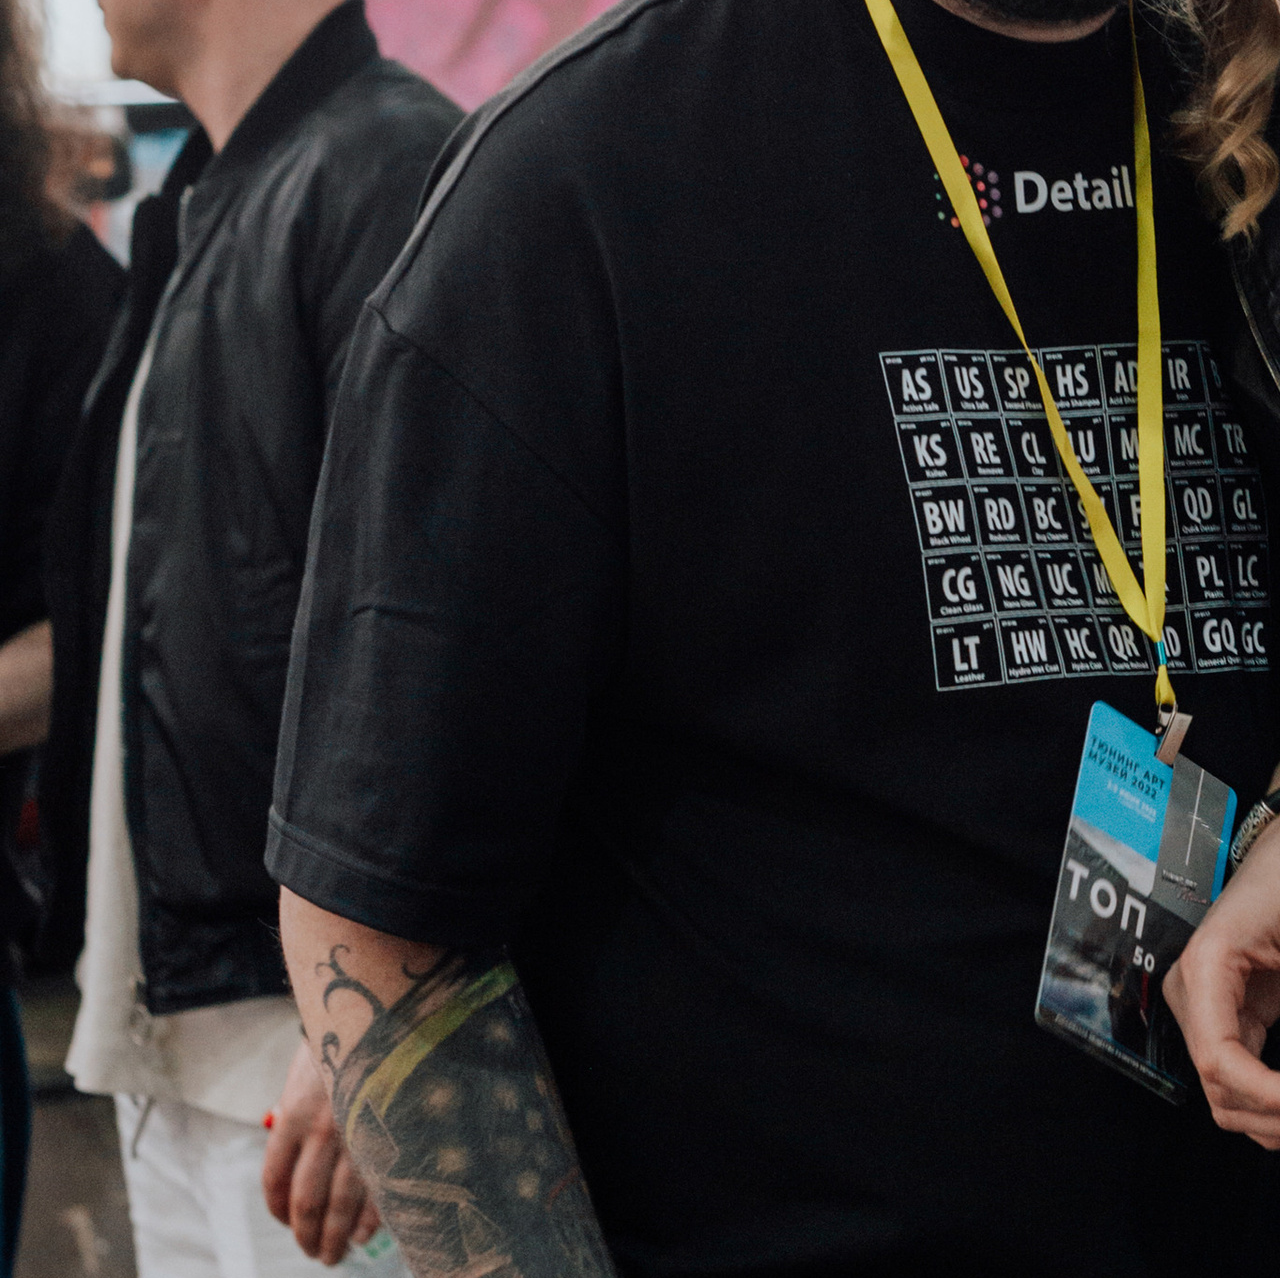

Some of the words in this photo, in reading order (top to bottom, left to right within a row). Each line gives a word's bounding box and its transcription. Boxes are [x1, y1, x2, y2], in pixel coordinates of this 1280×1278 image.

[1013, 165, 1135, 214] Detail
[902, 367, 932, 401] AS
[954, 366, 985, 400] US
[1004, 366, 1031, 399] SP
[1056, 362, 1090, 397] HS
[1167, 358, 1191, 390] IR
[913, 433, 948, 468] KS
[970, 431, 1001, 464] RE
[1021, 431, 1047, 464] CL
[1173, 423, 1205, 456] MC
[1222, 423, 1248, 454] TR
[923, 499, 967, 535] BW
[984, 497, 1015, 531] RD
[1032, 497, 1063, 530] BC
[1183, 486, 1213, 525] QD
[1232, 488, 1258, 520] GL
[942, 566, 978, 603] CG
[996, 564, 1032, 598] NG
[1046, 562, 1078, 596] UC
[1196, 555, 1225, 588] PL
[1237, 555, 1260, 587] LC
[1010, 629, 1048, 665] HW
[1063, 627, 1097, 660] HC
[1107, 624, 1141, 661] QR
[1203, 617, 1239, 655] GQ
[1241, 621, 1266, 654] GC
[952, 635, 981, 672] LT
[954, 671, 985, 684] Leather
[1090, 735, 1140, 775] ТЮНИНГ
[1143, 765, 1166, 792] АРТ
[1065, 858, 1148, 939] ТОП
[1132, 944, 1156, 973] 50
